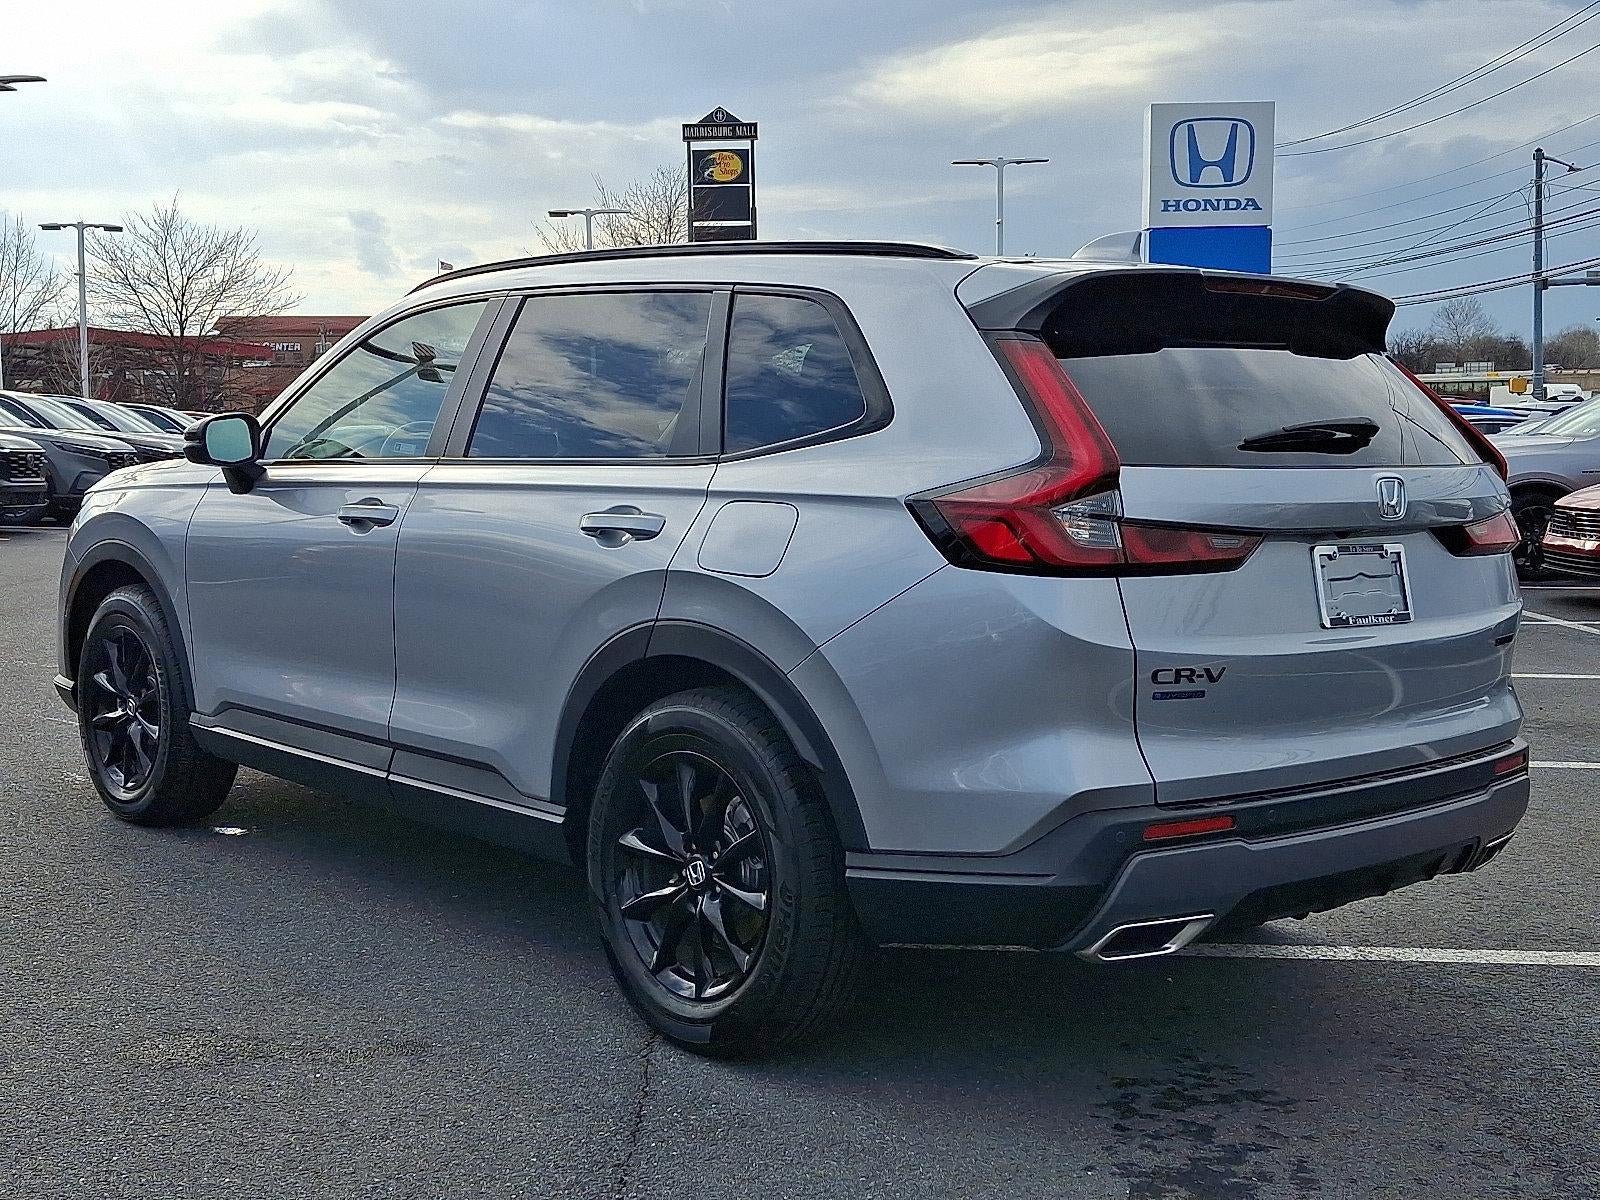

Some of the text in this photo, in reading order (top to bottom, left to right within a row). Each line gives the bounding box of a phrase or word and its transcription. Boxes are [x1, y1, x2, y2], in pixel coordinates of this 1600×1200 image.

[684, 125, 756, 137] HARRISBURG MALL
[1160, 198, 1263, 212] HONDA
[1348, 615, 1395, 625] Faulkner
[1151, 667, 1226, 684] CR-V
